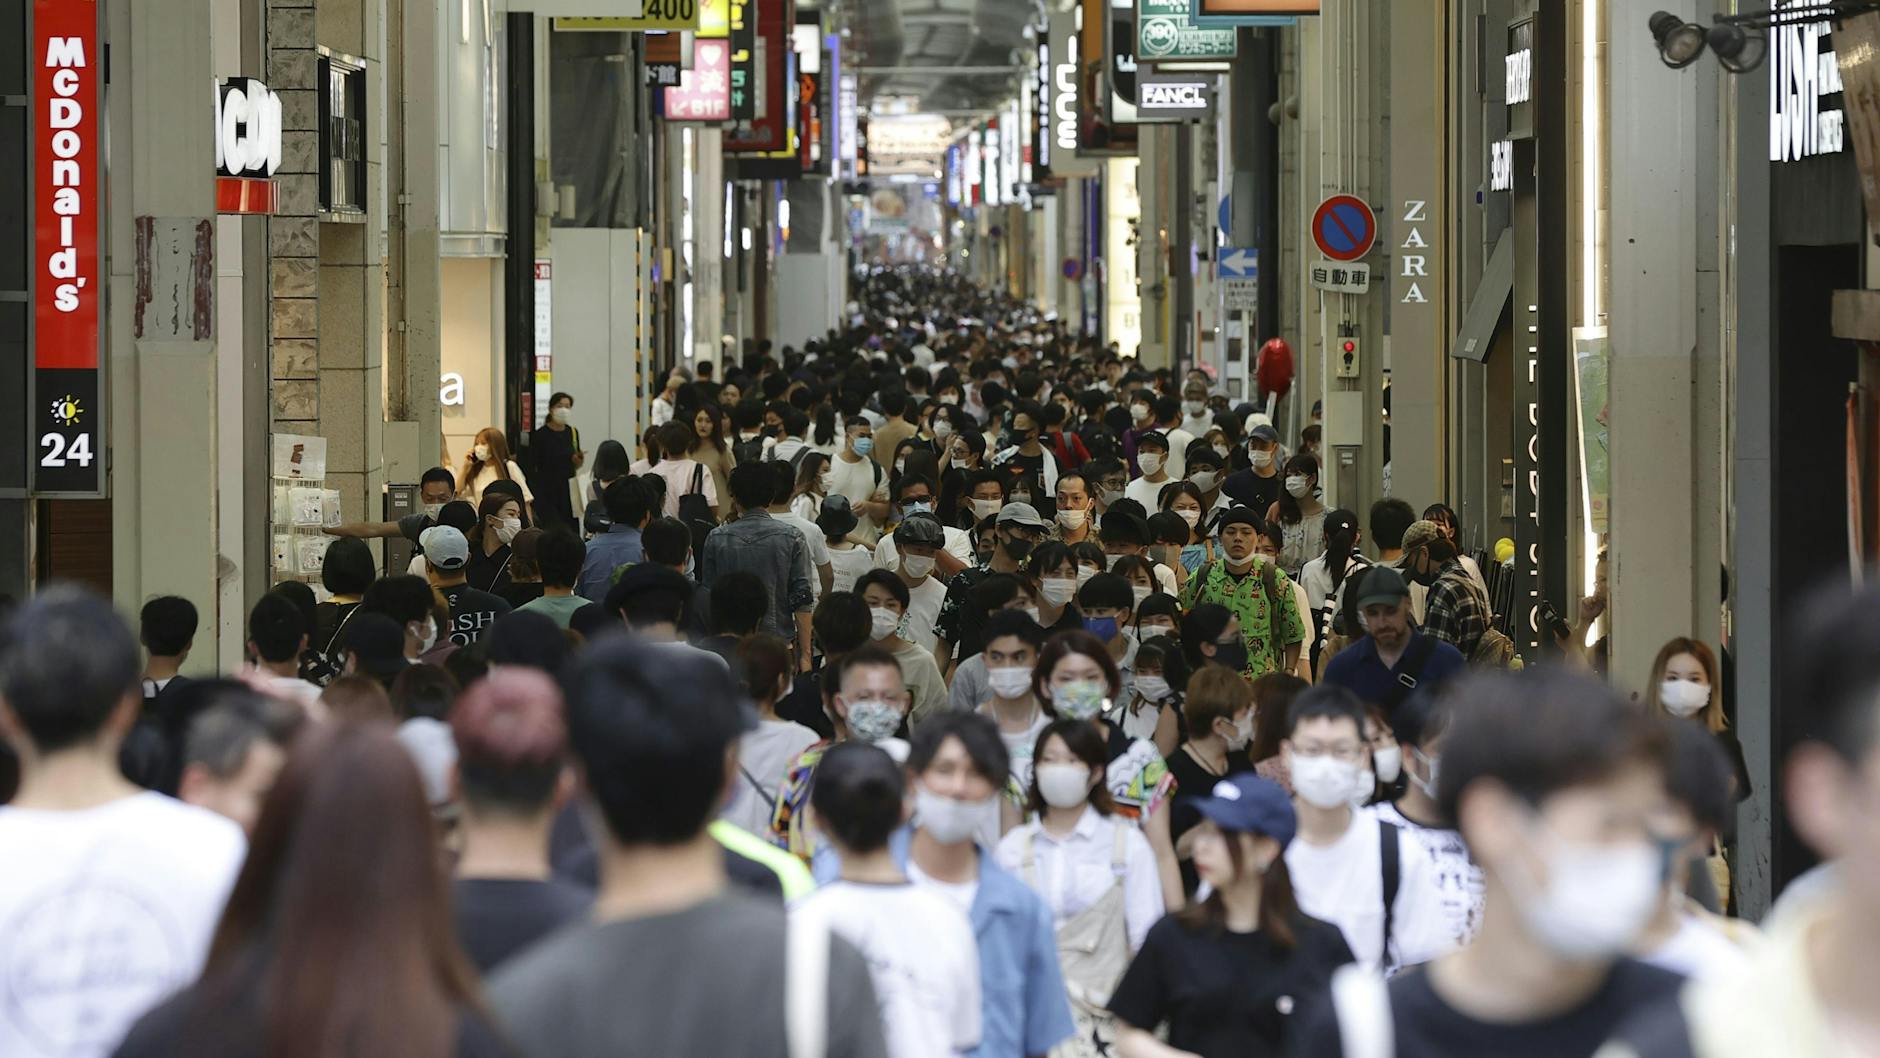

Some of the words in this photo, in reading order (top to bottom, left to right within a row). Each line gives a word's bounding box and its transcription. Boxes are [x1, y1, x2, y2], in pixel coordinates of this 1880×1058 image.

[1141, 86, 1206, 106] FANCL
[1769, 0, 1819, 163] LUSH
[46, 37, 86, 313] McDonald's
[1312, 266, 1369, 288] 自動車
[1401, 200, 1428, 304] ZARA
[40, 433, 93, 468] 24
